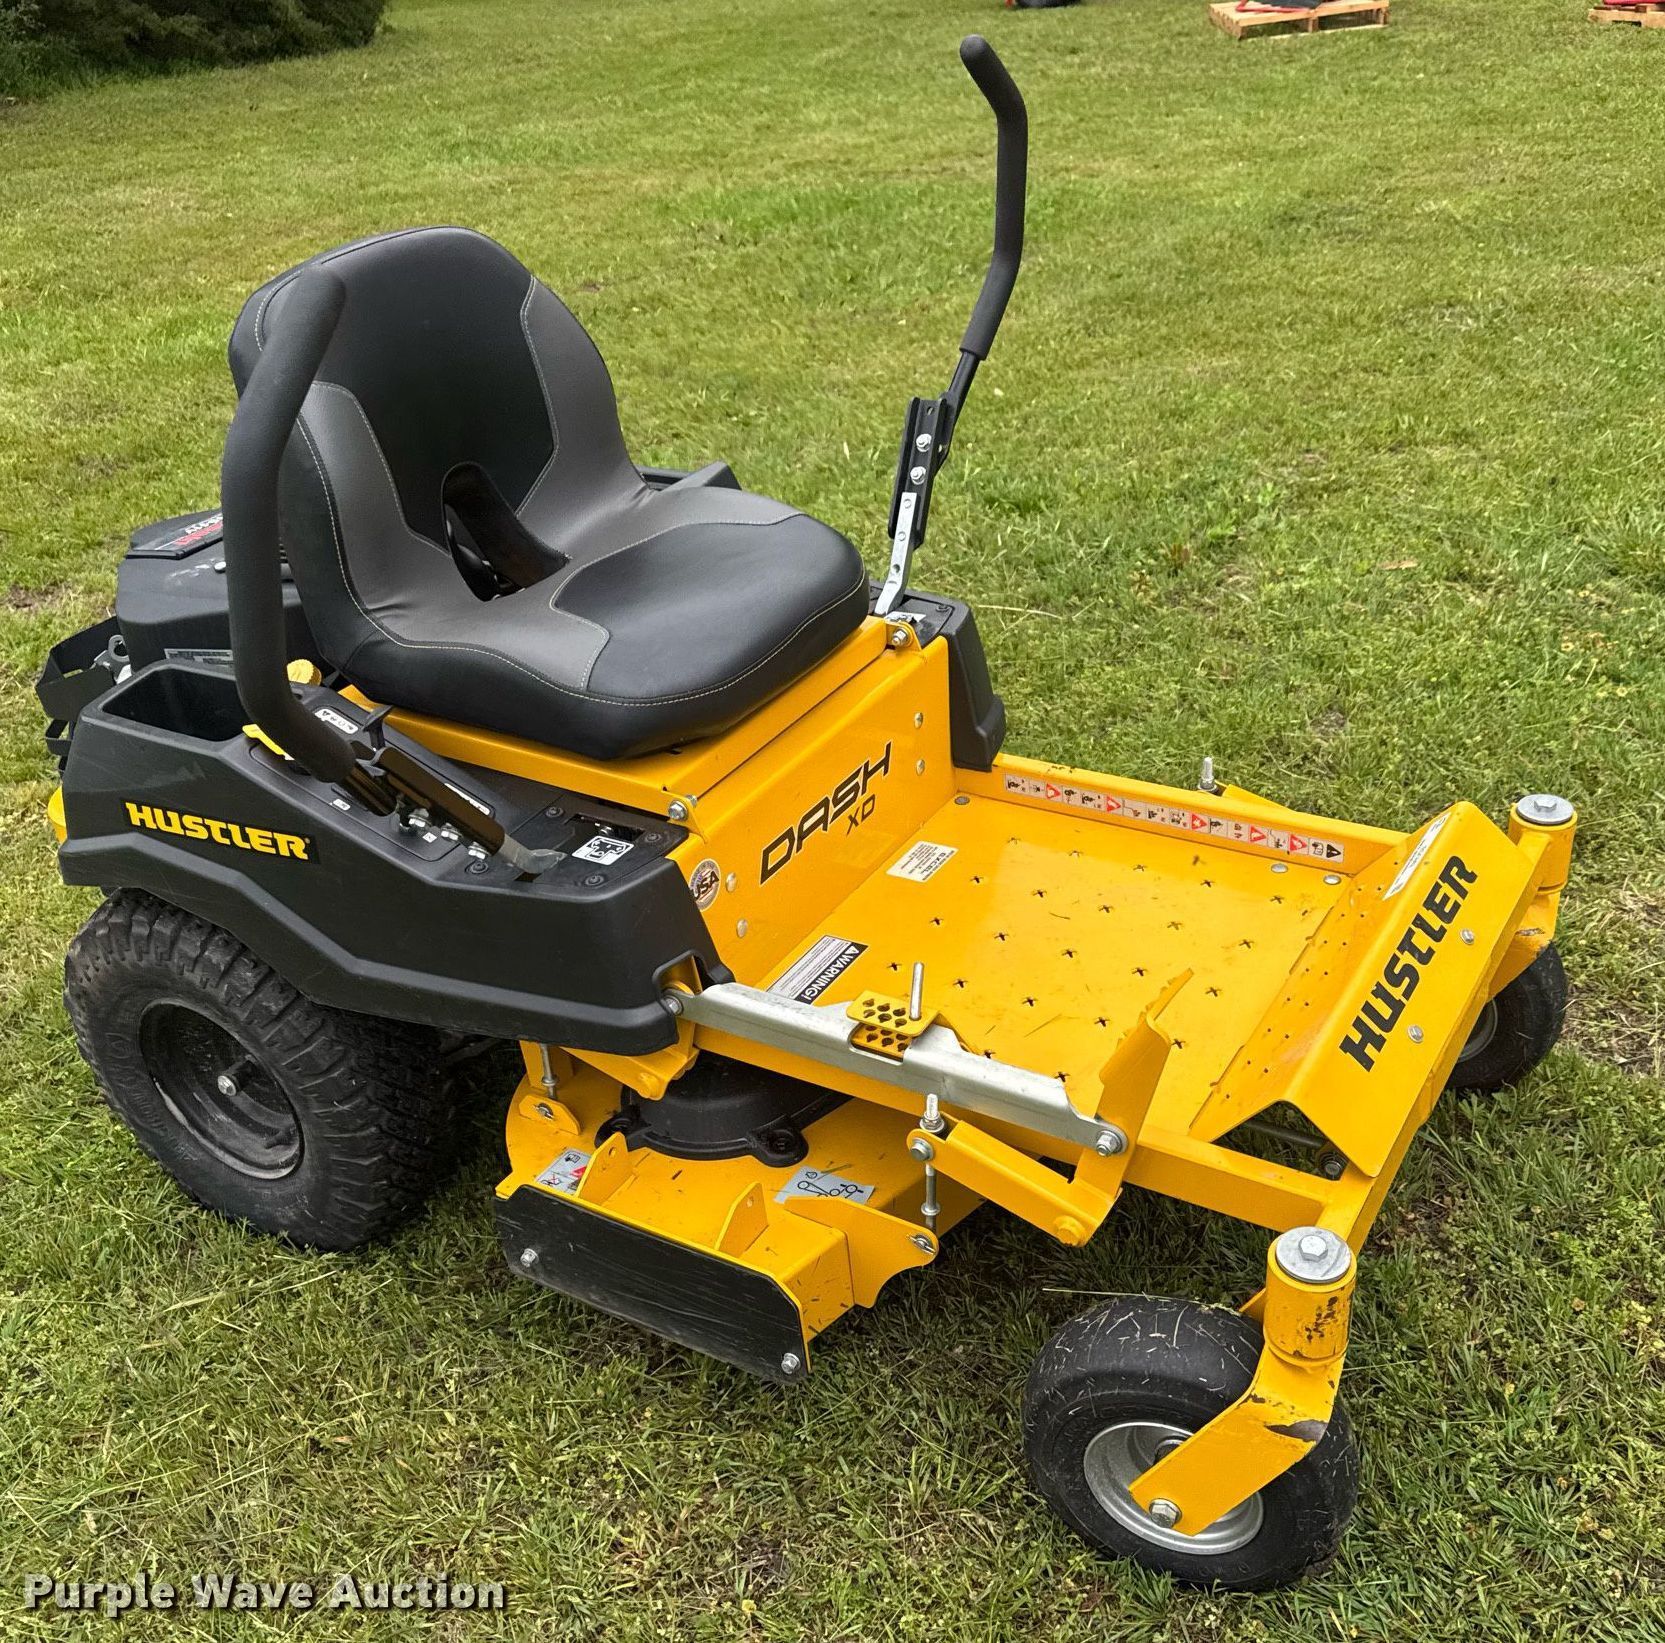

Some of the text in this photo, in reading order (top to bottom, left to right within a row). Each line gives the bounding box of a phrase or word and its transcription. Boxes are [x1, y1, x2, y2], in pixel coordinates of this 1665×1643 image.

[125, 802, 310, 860] HUSTLER
[760, 742, 891, 885] DASH
[846, 793, 876, 836] XD
[1339, 855, 1478, 1072] HUSTLER
